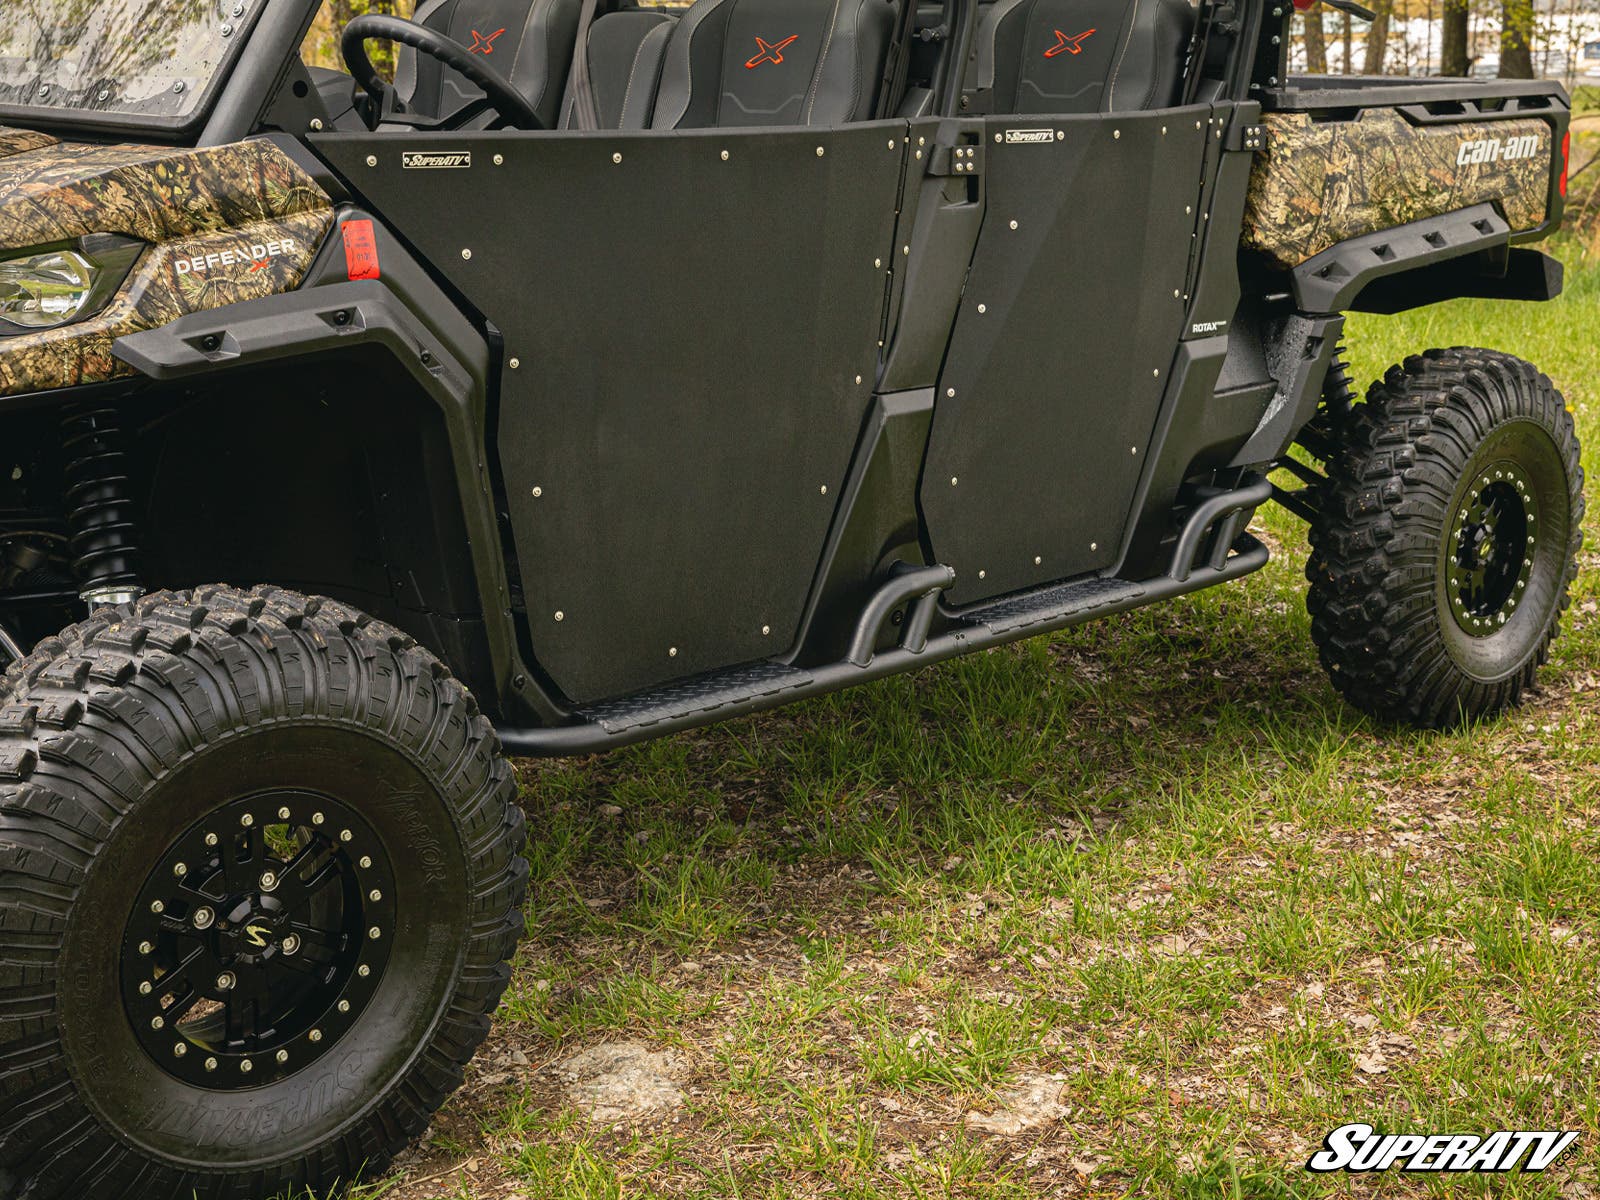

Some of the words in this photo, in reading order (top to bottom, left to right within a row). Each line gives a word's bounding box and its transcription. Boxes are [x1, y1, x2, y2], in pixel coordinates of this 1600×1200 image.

[408, 153, 465, 167] SUPERATV
[1456, 134, 1539, 166] can-am
[174, 238, 297, 275] DEFENDER
[1192, 321, 1218, 333] ROTAX
